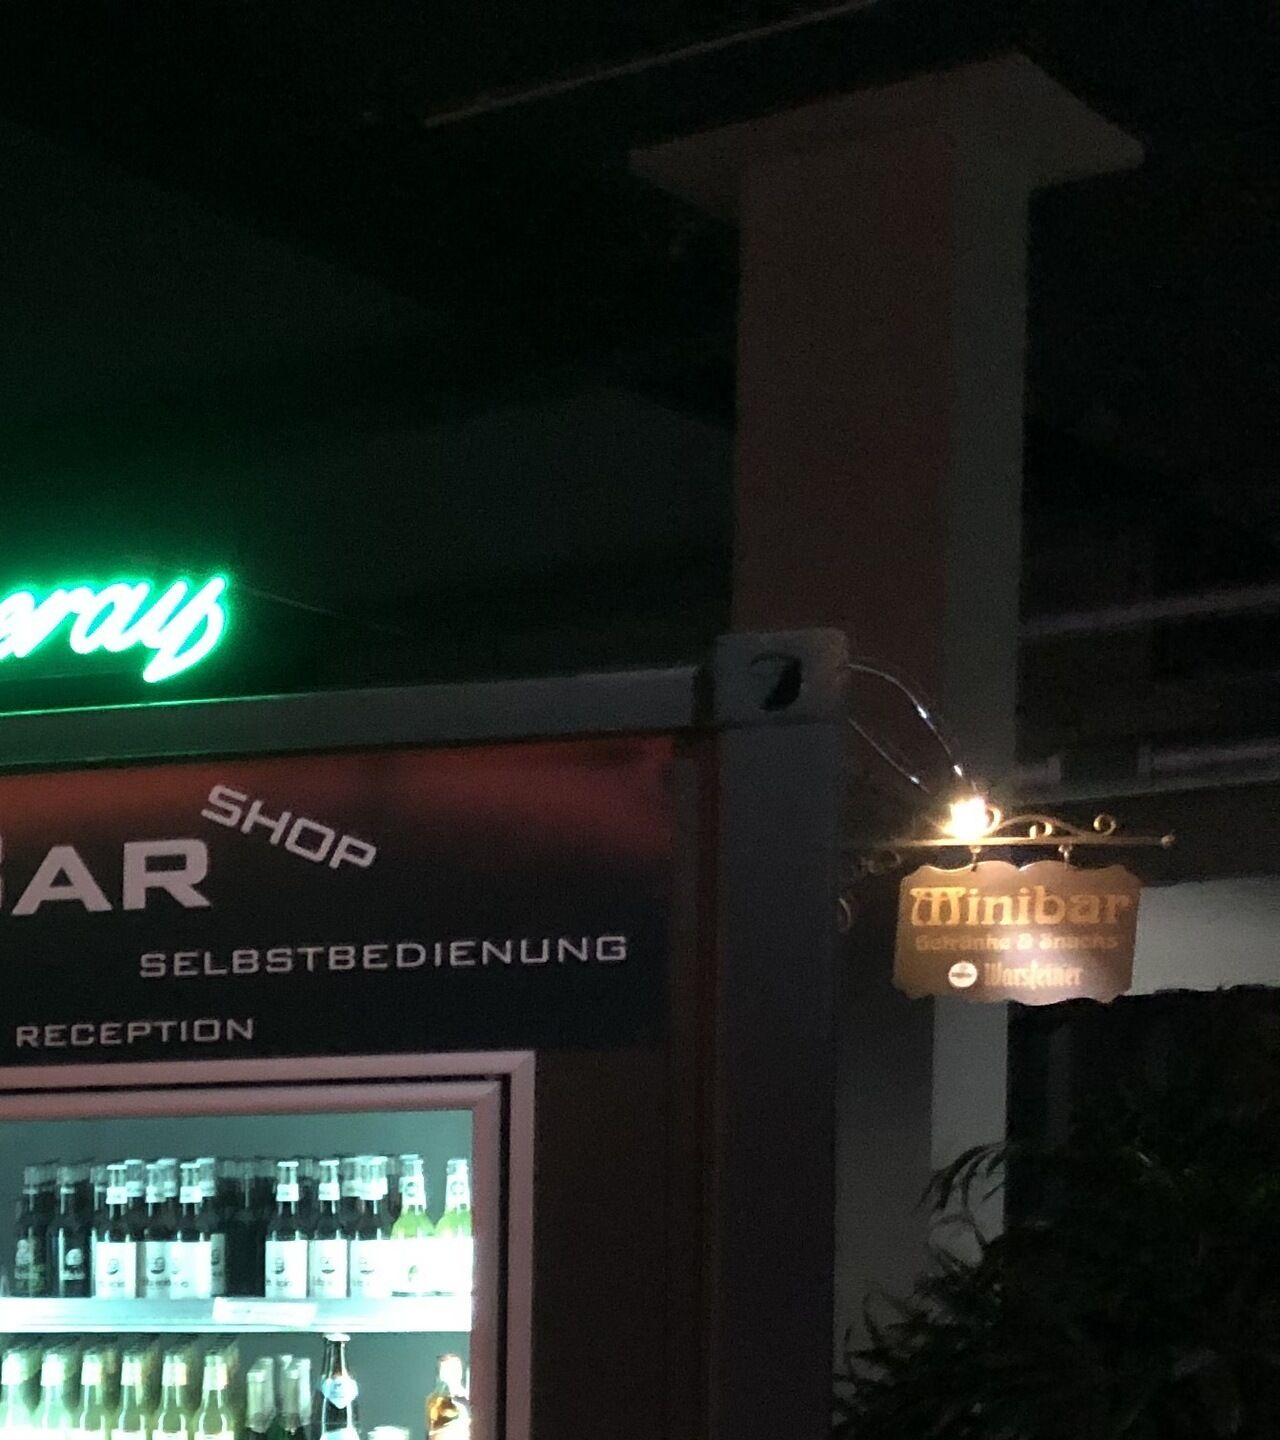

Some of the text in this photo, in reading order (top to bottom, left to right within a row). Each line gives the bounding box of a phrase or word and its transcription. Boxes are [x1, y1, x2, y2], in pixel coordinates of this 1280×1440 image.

[201, 782, 378, 872] SHOP
[908, 884, 1132, 926] Minibar
[138, 934, 629, 978] SELBSTBEDIENUNG
[14, 1017, 255, 1048] RECEPTION
